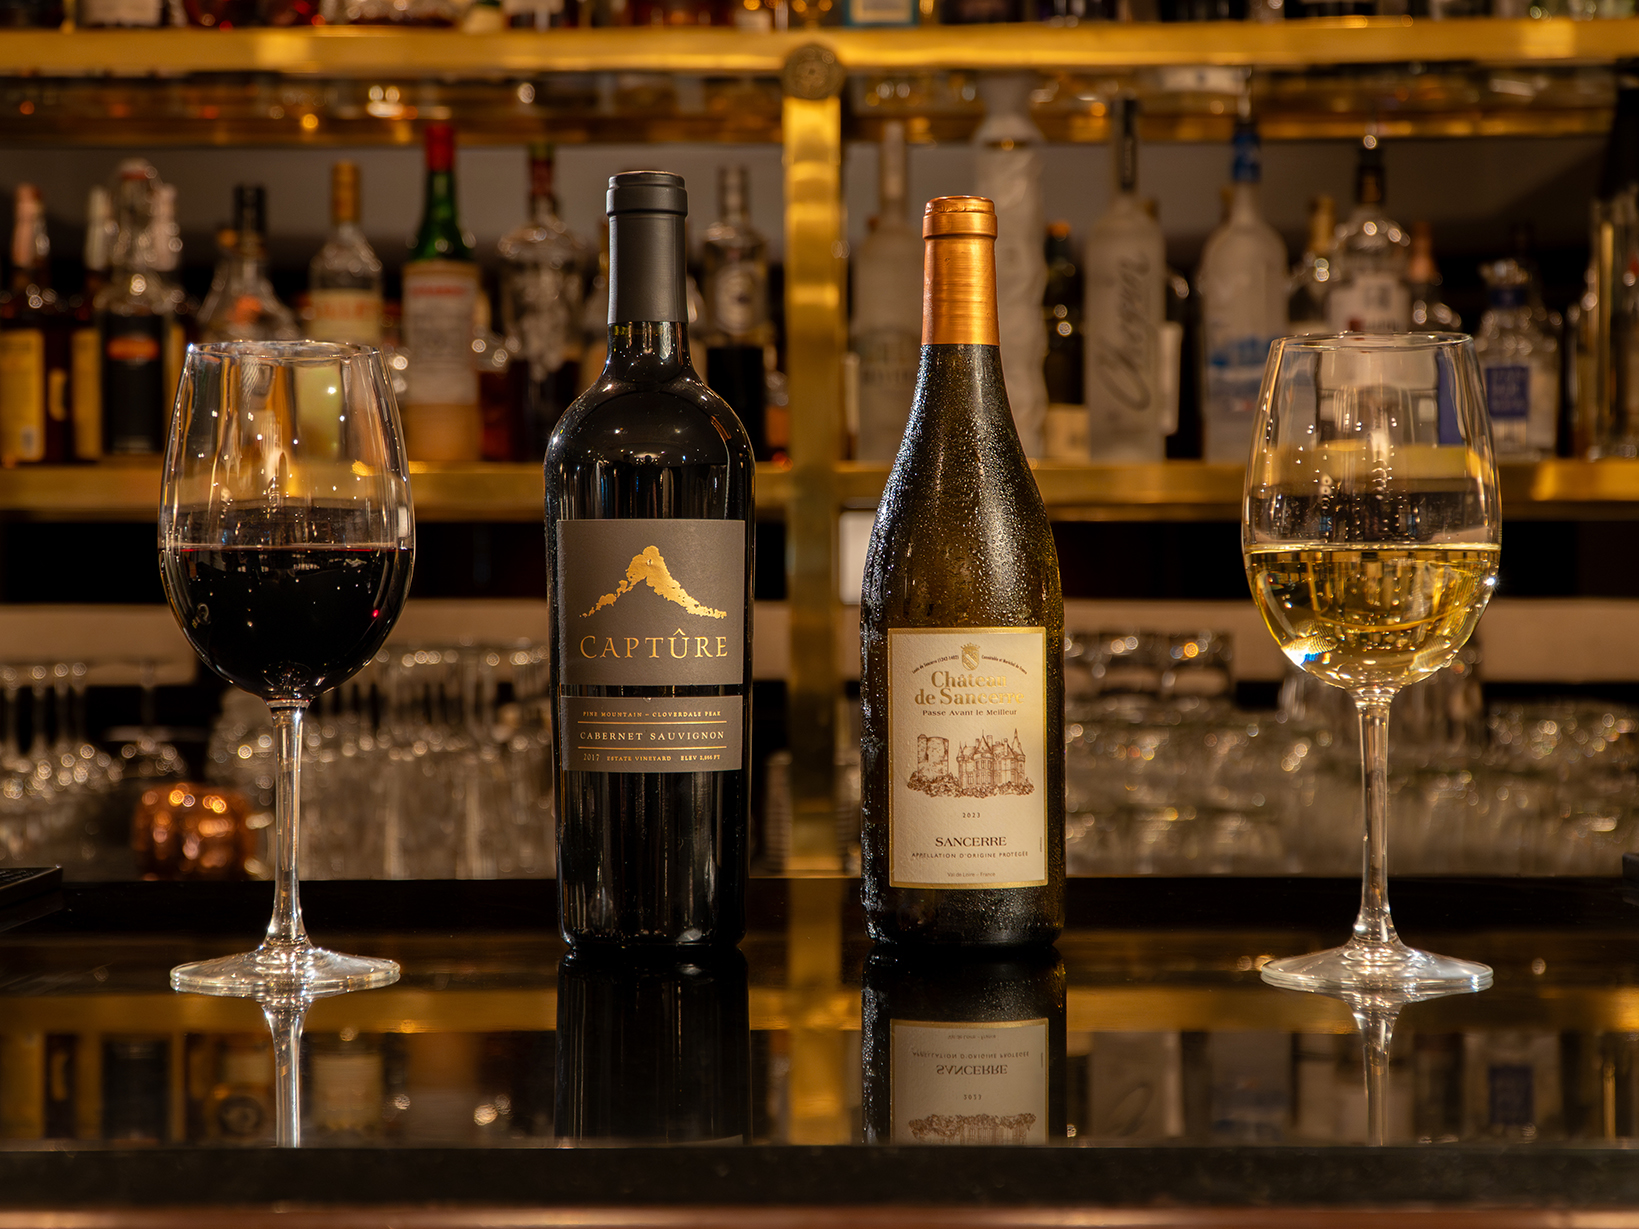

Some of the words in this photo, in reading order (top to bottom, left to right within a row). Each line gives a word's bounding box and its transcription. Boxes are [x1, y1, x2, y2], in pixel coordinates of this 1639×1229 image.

[580, 628, 728, 658] CAPTÛRE
[931, 670, 1007, 688] Château
[914, 689, 936, 705] de
[940, 688, 1025, 705] Sancerre
[580, 732, 643, 740] CABERNET
[650, 731, 724, 740] SAUVIGNON
[583, 753, 600, 761] 2017
[935, 837, 1007, 847] SANCERRE
